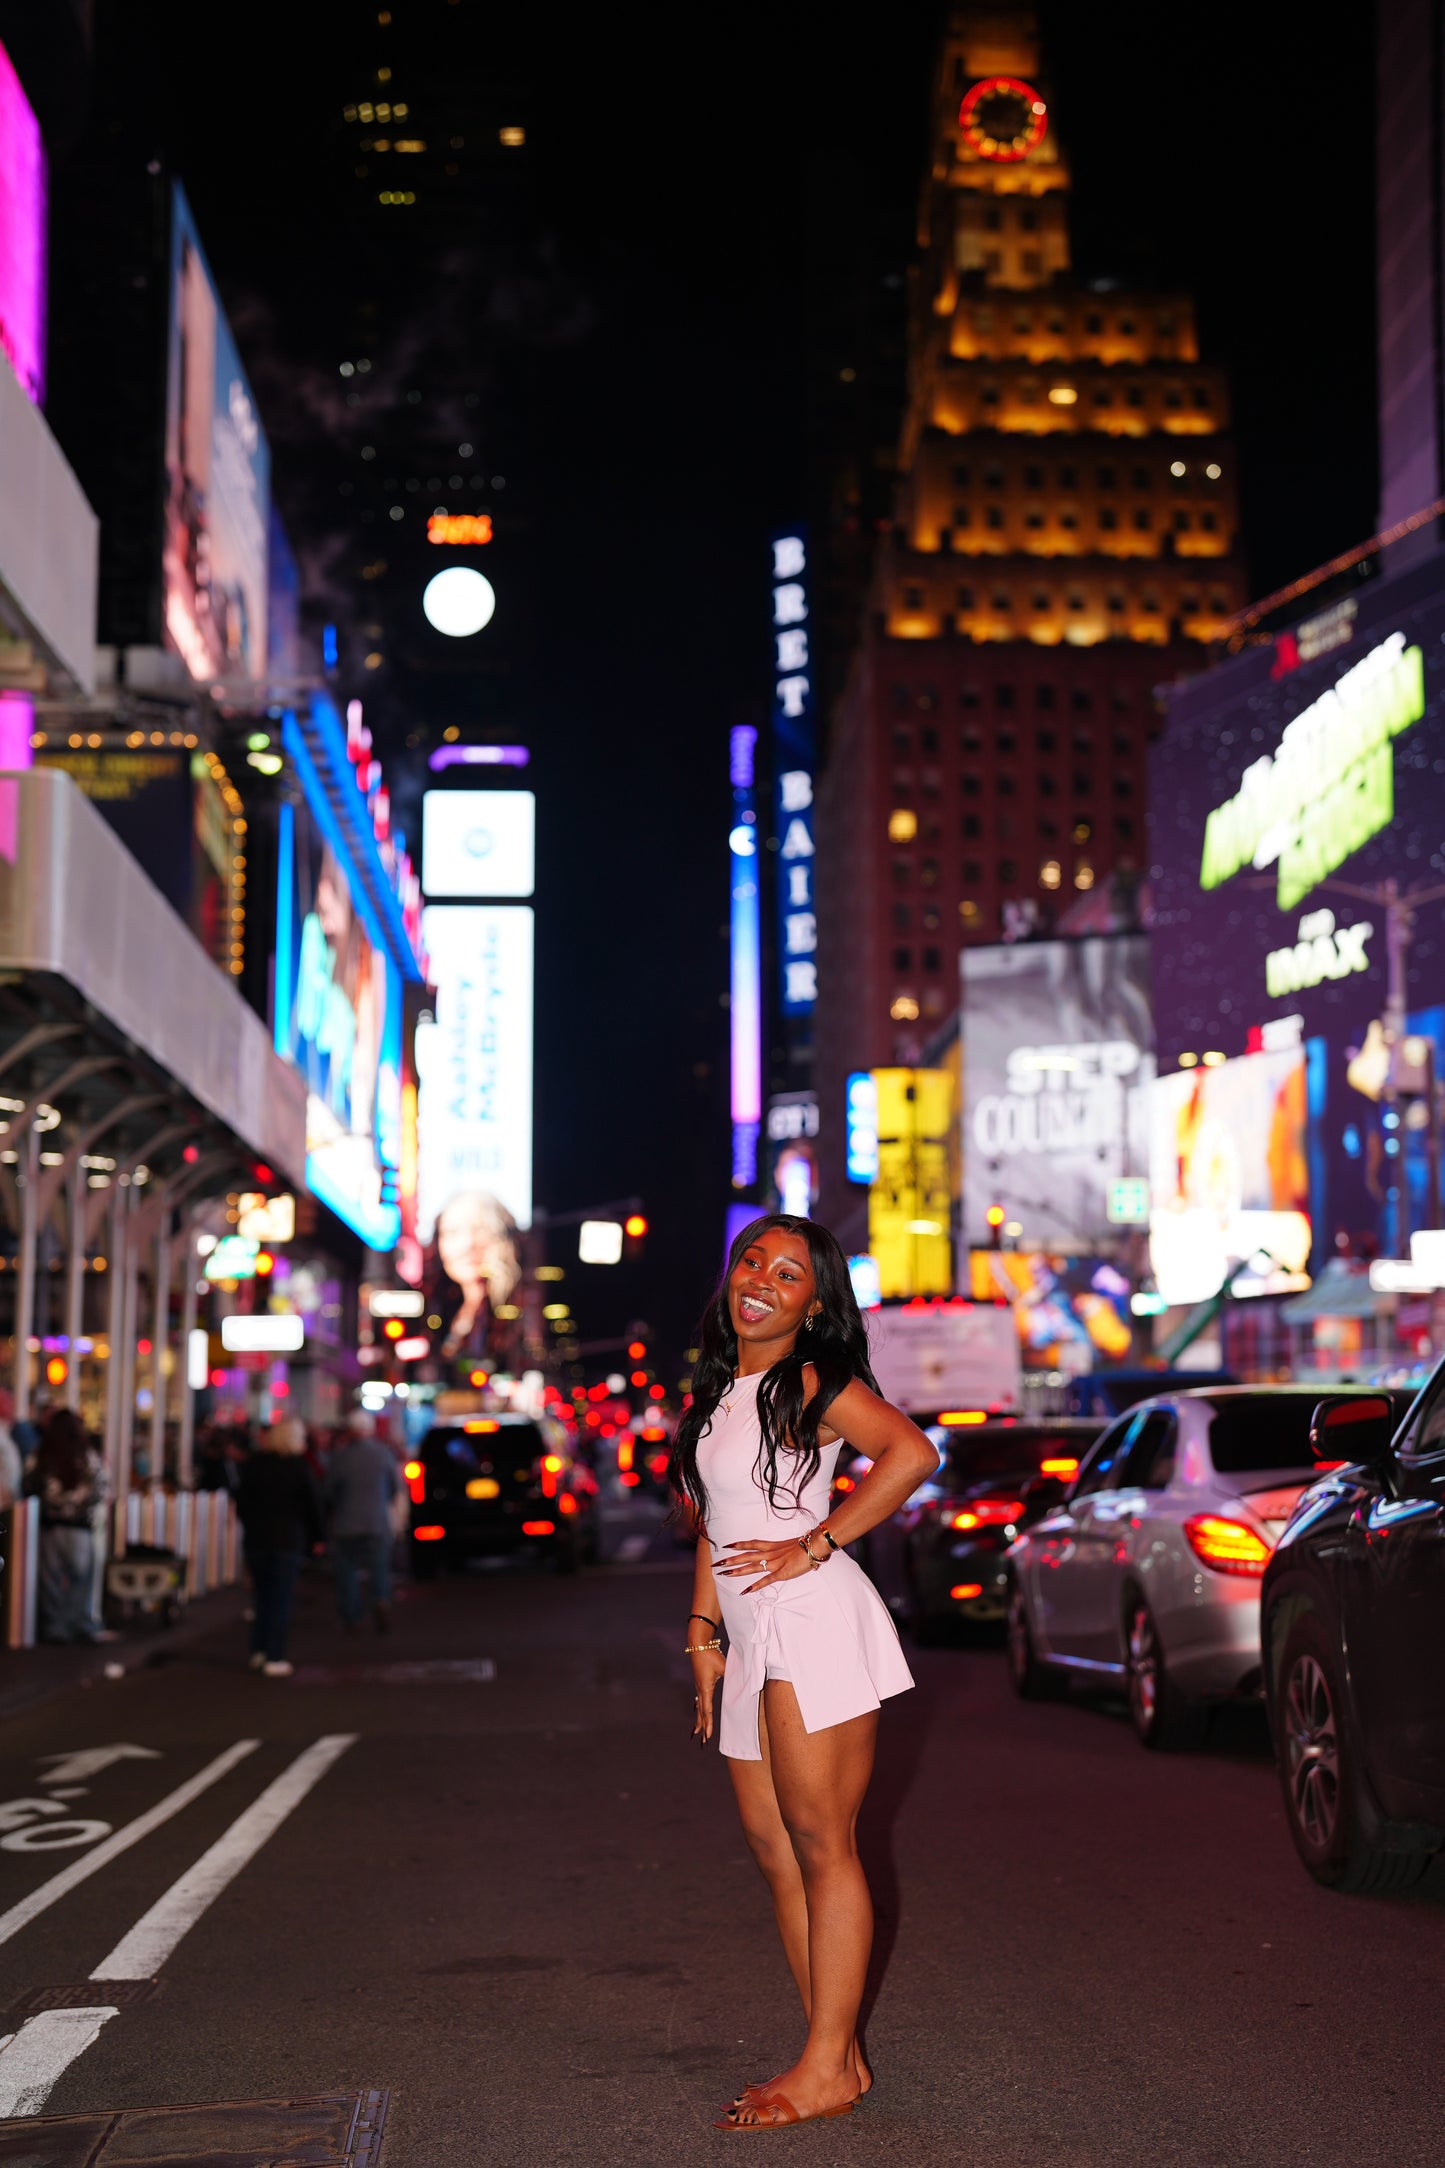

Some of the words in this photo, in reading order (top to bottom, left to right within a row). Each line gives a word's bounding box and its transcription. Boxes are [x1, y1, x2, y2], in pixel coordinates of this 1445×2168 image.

[772, 536, 809, 718] BRET
[780, 770, 818, 1003] BAIER
[1006, 1040, 1139, 1093] STEP
